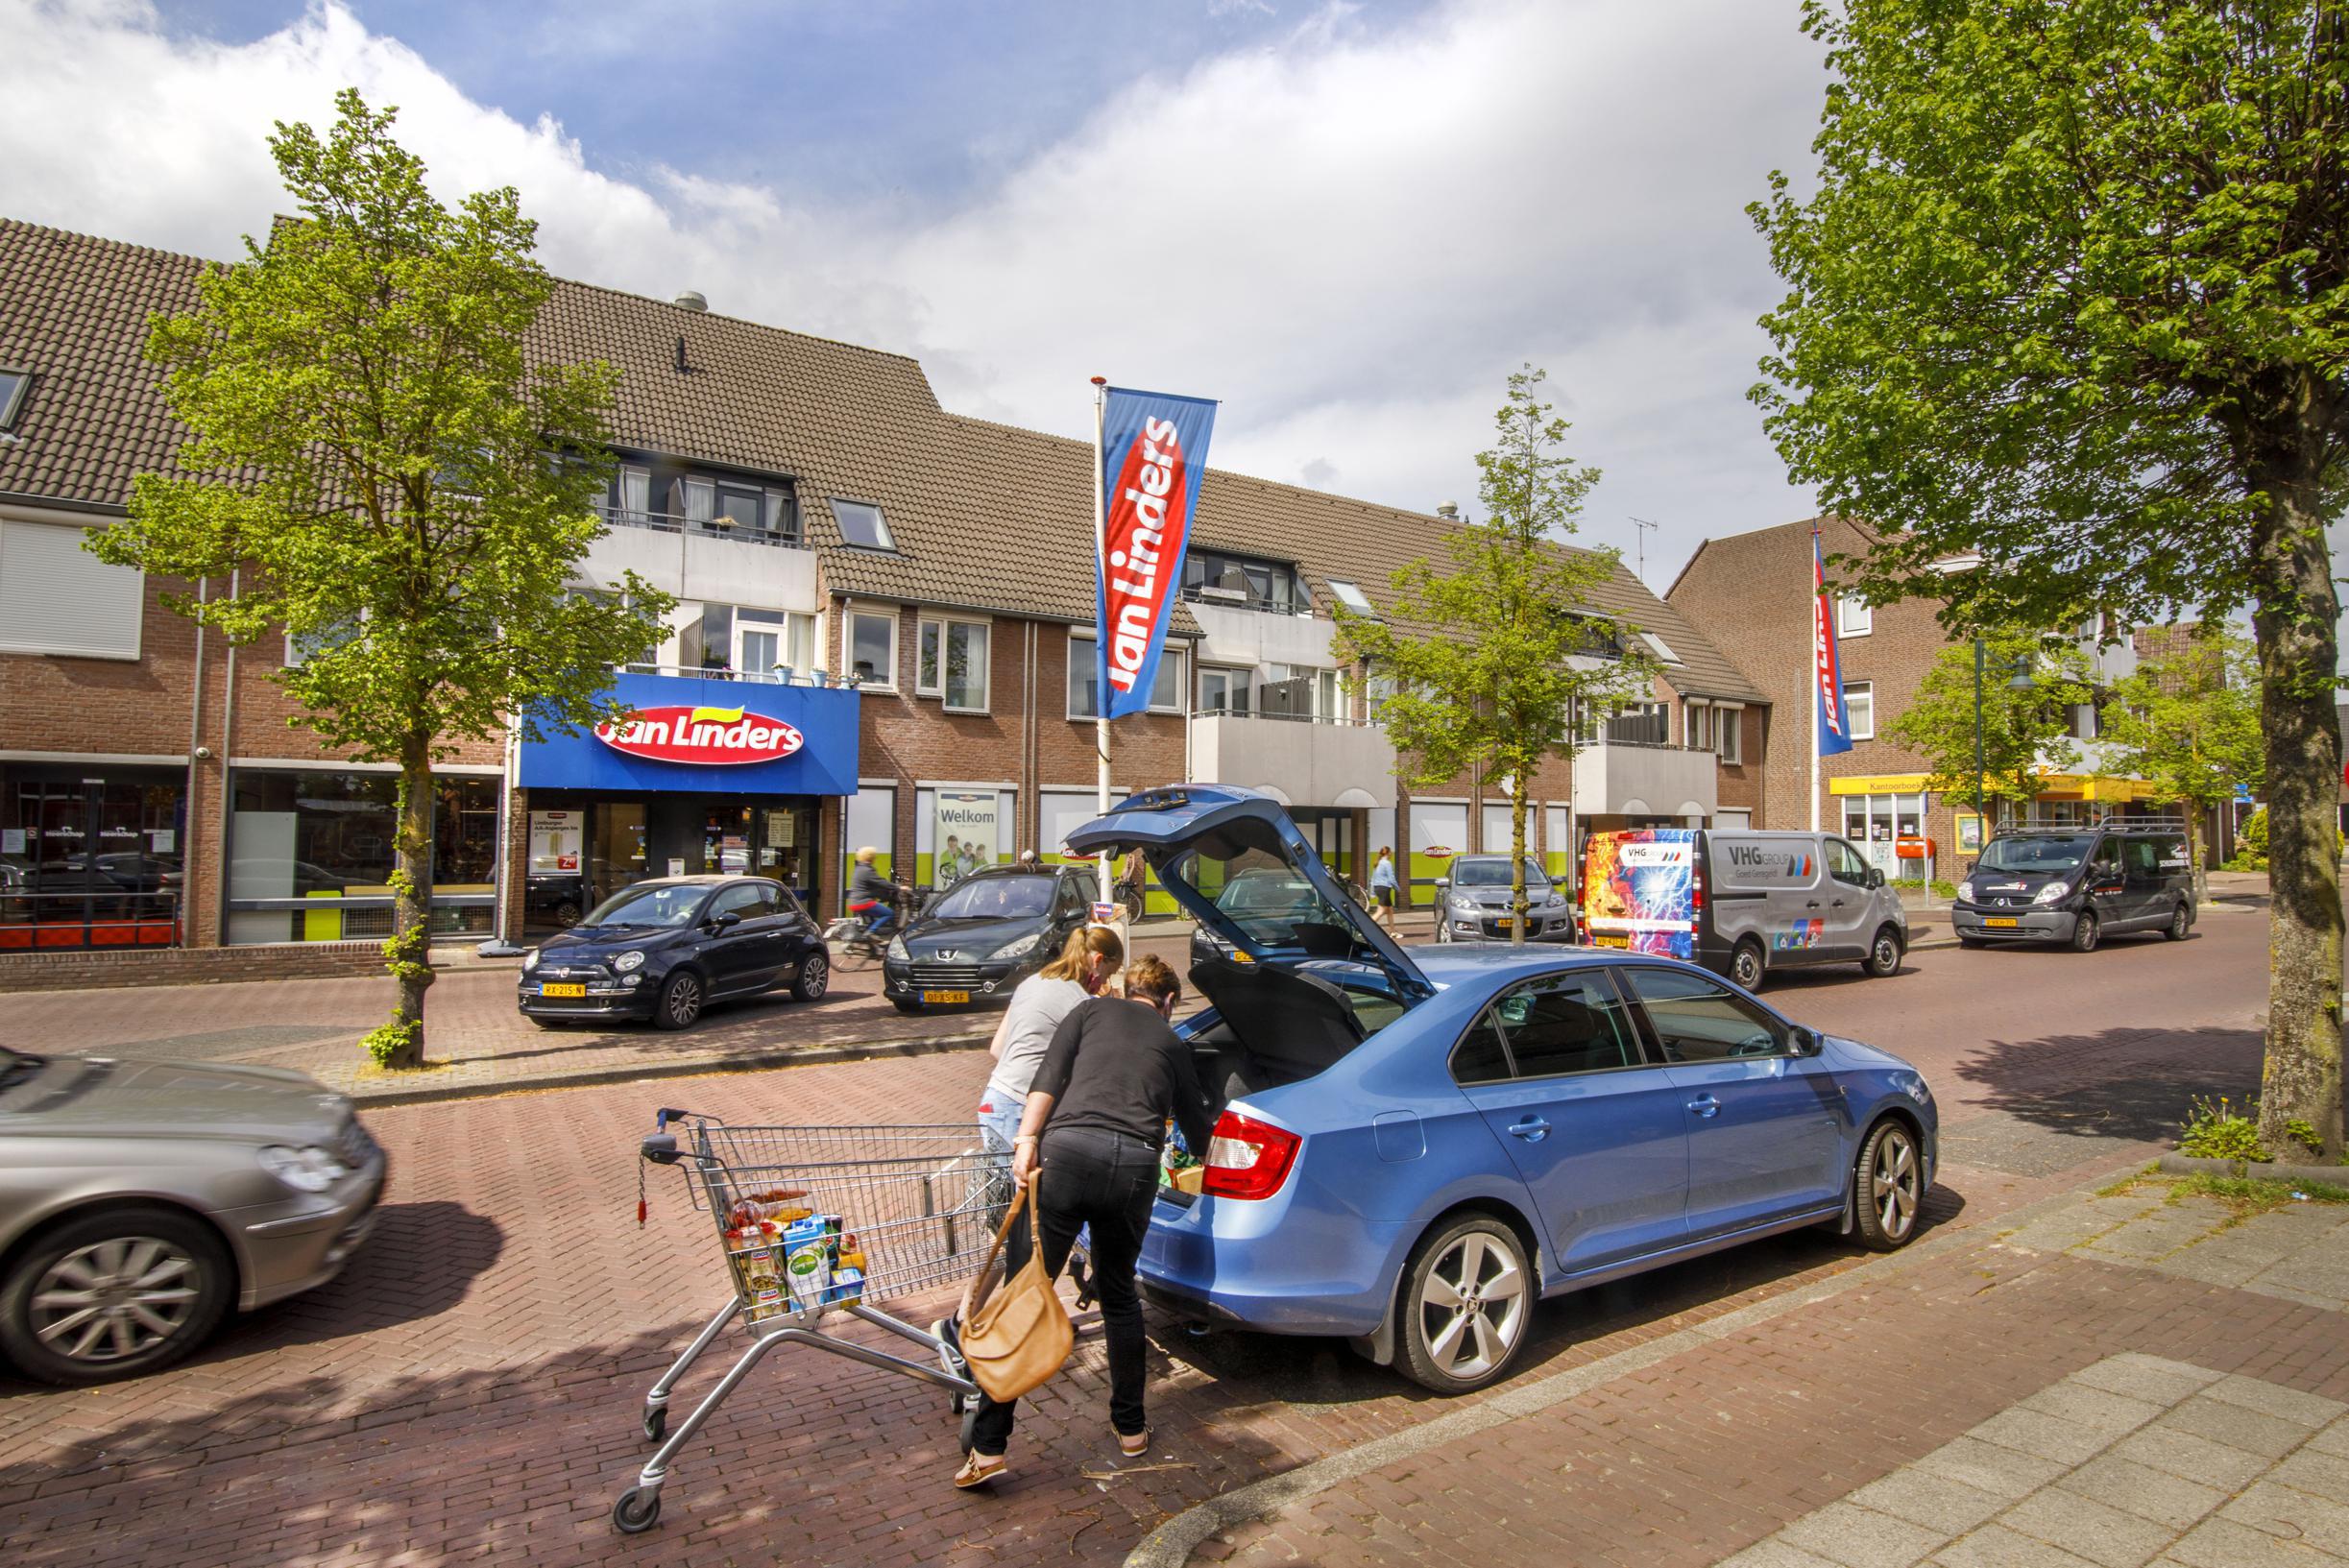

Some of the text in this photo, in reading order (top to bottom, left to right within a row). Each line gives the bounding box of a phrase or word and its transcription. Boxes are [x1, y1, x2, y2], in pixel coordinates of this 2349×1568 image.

[1108, 416, 1177, 693] Jan Linders
[1823, 674, 1842, 736] Jan
[672, 715, 803, 751] Linders
[1870, 782, 1923, 791] Kantoorboek
[941, 808, 994, 823] Welkom
[1729, 847, 1761, 865] VHG
[545, 985, 582, 995] RX-215-N
